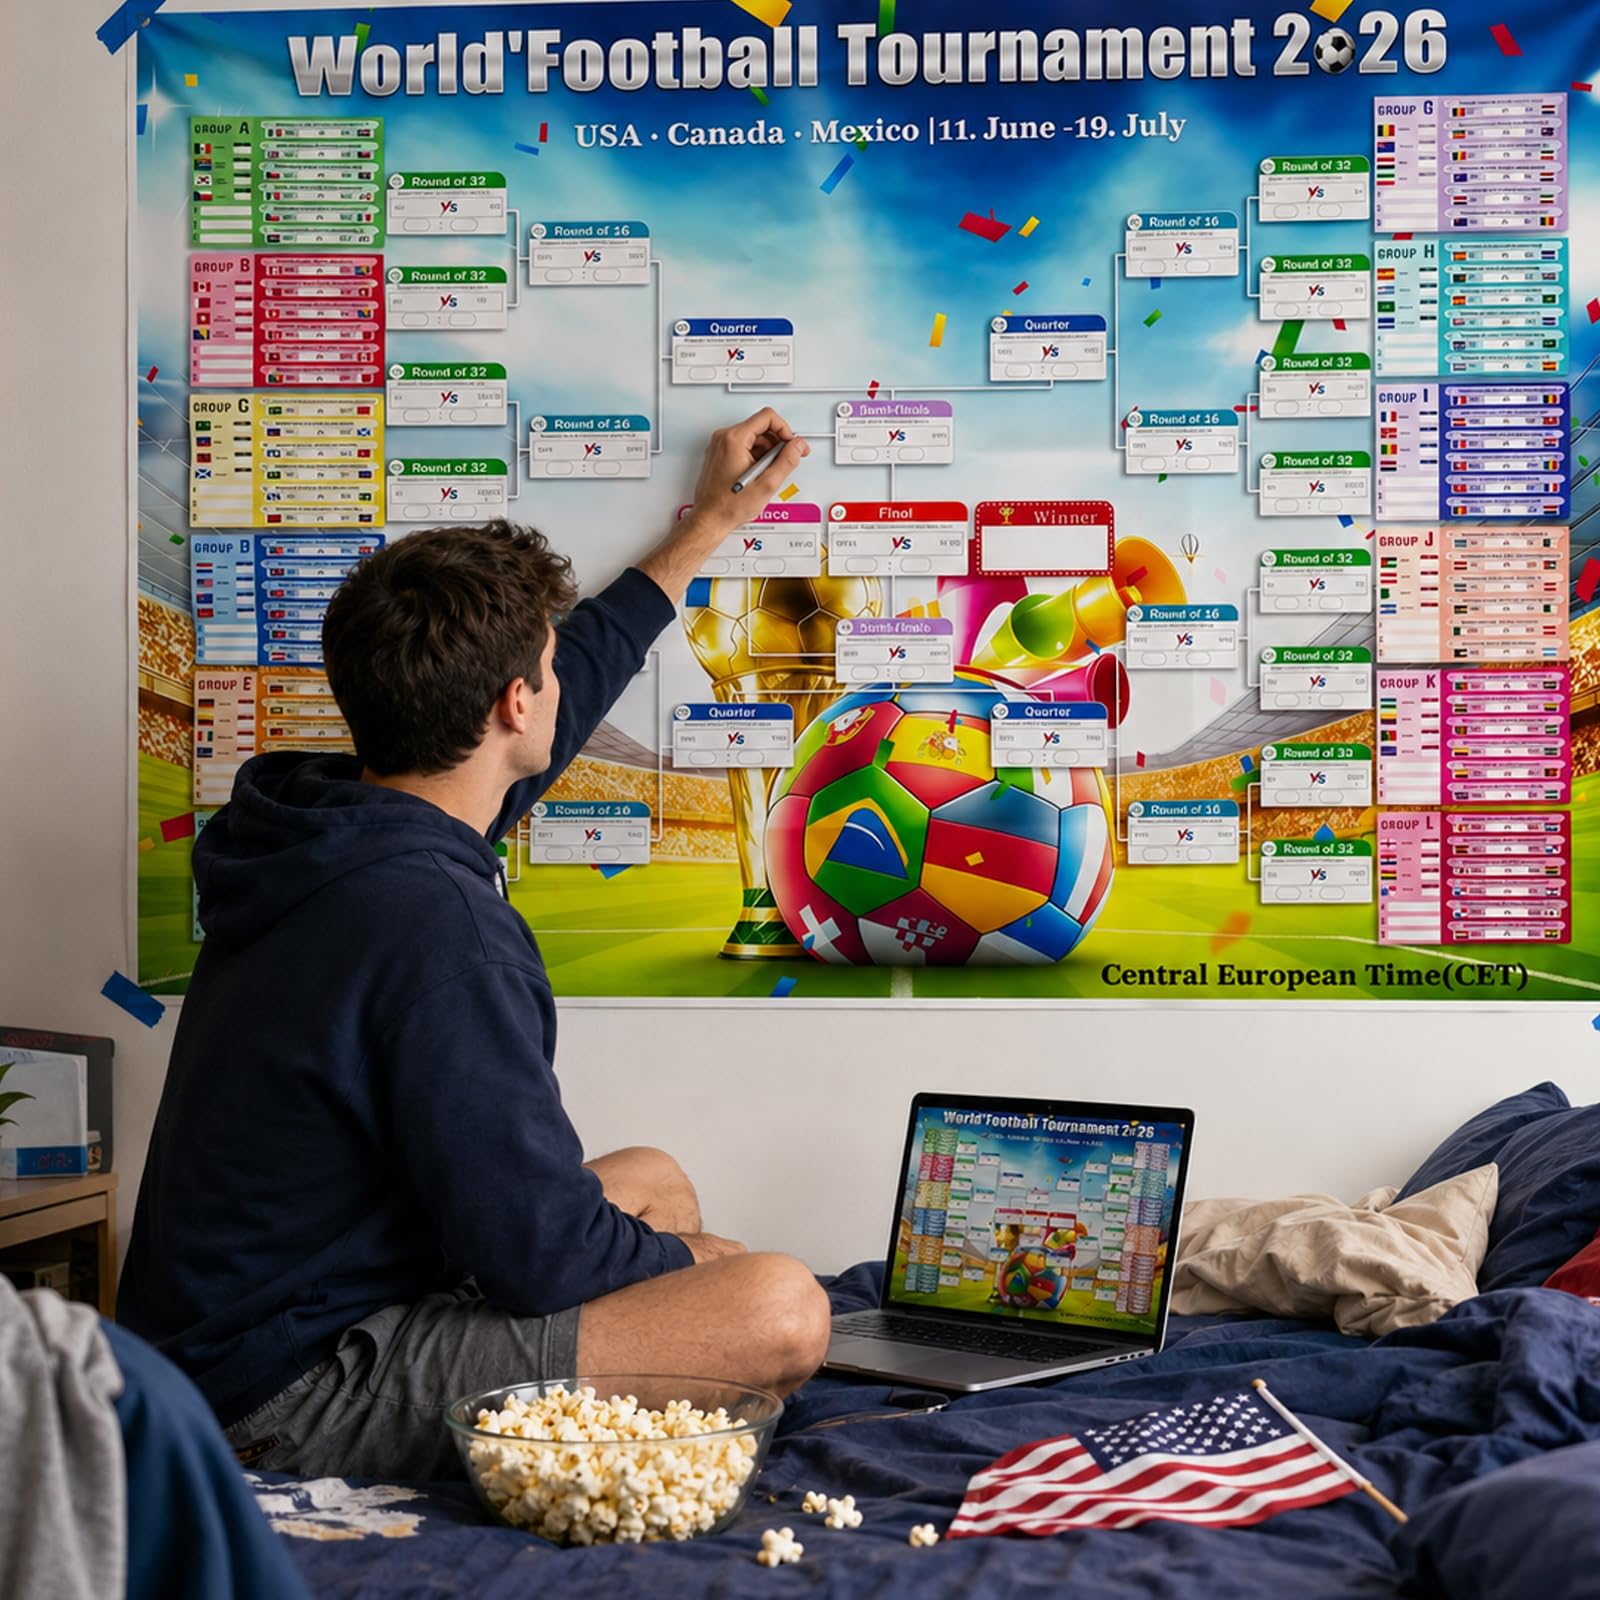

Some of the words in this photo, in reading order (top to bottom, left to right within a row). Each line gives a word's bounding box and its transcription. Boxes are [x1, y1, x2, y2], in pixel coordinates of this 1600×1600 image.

[837, 19, 1258, 87] Tournament
[1377, 104, 1417, 116] GROUP
[1422, 100, 1434, 115] G
[239, 121, 250, 135] A
[574, 123, 643, 148] USA
[667, 119, 786, 146] Canada
[810, 117, 920, 144] Mexico
[983, 116, 1056, 141] June
[1122, 112, 1187, 142] July
[1320, 160, 1333, 171] of
[411, 176, 451, 188] Round
[453, 175, 467, 187] of
[469, 175, 486, 187] 32
[1188, 215, 1202, 227] of
[554, 225, 593, 237] Round
[596, 225, 610, 236] of
[1377, 247, 1417, 260] GROUP
[1423, 244, 1435, 259] H
[193, 261, 234, 273] GROUP
[239, 257, 250, 272] B
[1320, 258, 1334, 270] of
[410, 270, 451, 281] Round
[453, 270, 468, 281] of
[469, 270, 487, 281] 32
[1320, 356, 1334, 368] of
[1336, 356, 1353, 368] 32
[411, 366, 451, 378] Round
[453, 367, 468, 378] of
[469, 366, 487, 378] 32
[1422, 388, 1429, 403] I
[554, 419, 594, 430] Round
[597, 418, 611, 430] of
[1149, 413, 1187, 425] Round
[1188, 413, 1201, 425] of
[1282, 455, 1320, 467] Round
[1321, 454, 1335, 467] of
[1337, 454, 1353, 467] 32
[411, 462, 451, 473] Round
[454, 462, 468, 473] of
[470, 462, 488, 473] 32
[1033, 509, 1098, 525] Winner
[1379, 535, 1419, 547] GROUP
[1424, 531, 1434, 546] J
[1282, 553, 1320, 564] Round
[1321, 553, 1335, 564] of
[1336, 552, 1353, 564] 32
[1188, 608, 1202, 620] of
[1322, 650, 1335, 661] of
[1337, 649, 1354, 662] 32
[197, 679, 238, 691] GROUP
[242, 676, 253, 691] E
[1425, 674, 1436, 689] K
[597, 805, 611, 816] of
[1425, 816, 1434, 830] L
[1321, 842, 1335, 854] of
[1101, 962, 1208, 986] Central
[1217, 963, 1357, 991] European
[1364, 962, 1529, 992] Time(CET)
[1042, 1117, 1119, 1136] Tournament
